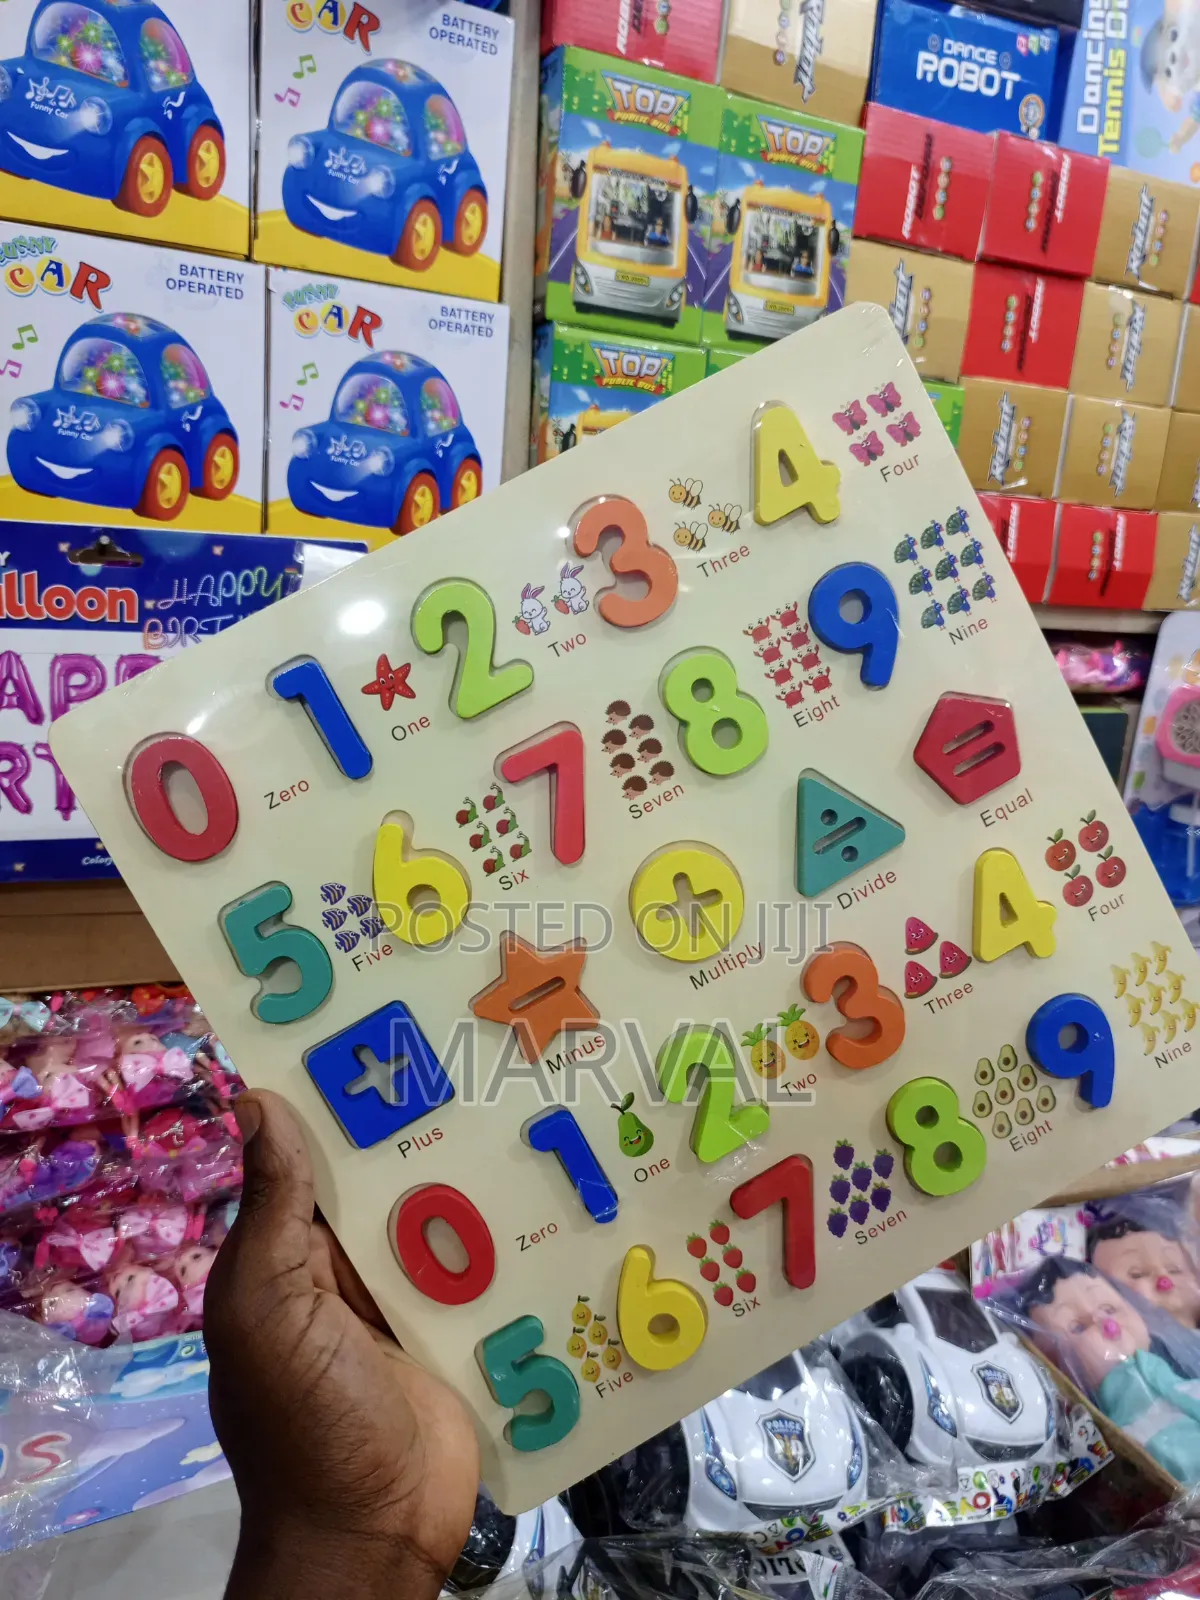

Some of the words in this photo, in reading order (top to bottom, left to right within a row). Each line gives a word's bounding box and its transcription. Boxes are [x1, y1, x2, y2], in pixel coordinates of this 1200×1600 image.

[288, 0, 381, 53] CAR
[429, 26, 499, 56] OPERATED
[441, 14, 499, 41] BATTERY
[943, 38, 998, 65] DANCE
[916, 51, 1021, 100] ROBOT
[30, 101, 54, 115] Funny
[54, 108, 69, 119] Car
[612, 80, 677, 115] TOP
[766, 123, 824, 157] TOP
[902, 164, 921, 241] ROBOT
[7, 258, 112, 311] CAR
[166, 277, 245, 300] OPERATED
[179, 263, 245, 286] BATTERY
[294, 303, 384, 350] CAR
[428, 319, 494, 339] OPERATED
[440, 306, 495, 325] BATTERY
[600, 350, 663, 378] TOP
[603, 377, 637, 387] PUBLIC
[636, 380, 657, 392] BUS
[752, 402, 841, 525] 4
[880, 455, 921, 483] Four
[570, 496, 678, 627] 3
[697, 543, 750, 579] Three
[0, 570, 139, 623] lloon
[157, 566, 283, 610] HAPPY
[809, 562, 898, 689] 9
[949, 618, 989, 645] Nine
[412, 580, 534, 719] 2
[548, 632, 587, 658] Two
[268, 657, 373, 779] 1
[391, 714, 431, 741] One
[664, 650, 768, 774] 8
[793, 696, 840, 728] Eight
[126, 732, 239, 862] 0
[264, 779, 310, 810] Zero
[498, 724, 584, 865] 7
[629, 782, 685, 819] Seven
[979, 788, 1034, 828] Equal
[372, 815, 472, 946] 6
[499, 868, 530, 891] Six
[837, 868, 898, 910] Divide
[973, 848, 1057, 962] 4
[1087, 893, 1126, 922] Four
[222, 883, 333, 1024] 5
[351, 943, 393, 972] Five
[689, 942, 764, 990] Multiply
[802, 942, 905, 1070] 3
[924, 980, 974, 1015] Three
[545, 1033, 606, 1075] Minus
[1026, 994, 1115, 1108] 9
[1154, 1041, 1193, 1069] Nine
[656, 1027, 769, 1163] 2
[781, 1071, 818, 1098] Two
[397, 1126, 444, 1159] Plus
[886, 1076, 987, 1197] 8
[1009, 1119, 1054, 1152] Eight
[524, 1106, 619, 1224] 1
[634, 1157, 671, 1184] One
[515, 1221, 559, 1252] Zero
[729, 1154, 816, 1289] 7
[854, 1208, 908, 1246] Seven
[390, 1184, 495, 1306] 0
[617, 1245, 707, 1371] 6
[732, 1296, 762, 1319] Six
[477, 1315, 581, 1452] 5
[595, 1370, 634, 1398] Five
